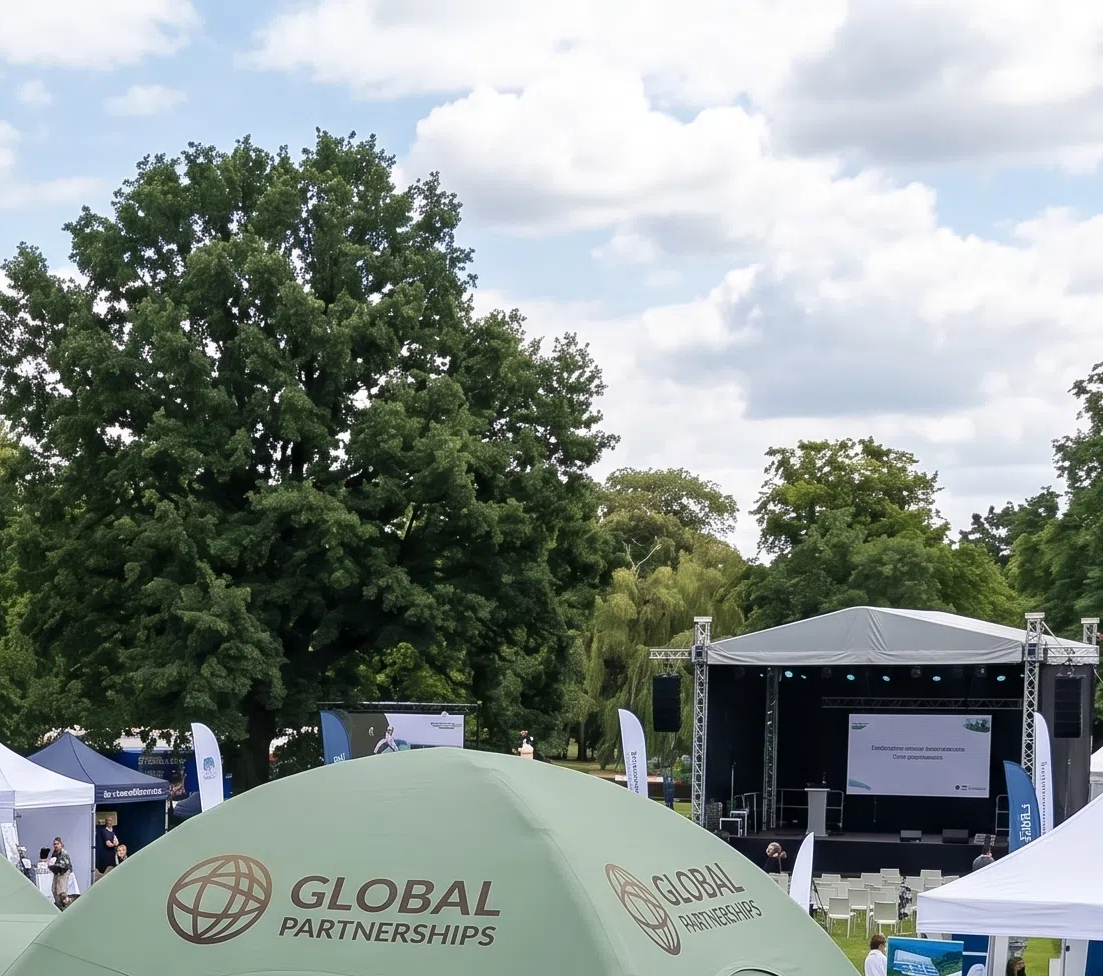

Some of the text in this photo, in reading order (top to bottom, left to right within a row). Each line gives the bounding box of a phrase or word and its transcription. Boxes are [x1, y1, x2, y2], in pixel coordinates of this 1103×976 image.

[290, 875, 501, 917] GLOBAL
[652, 862, 746, 906] GLOBAL
[278, 916, 497, 947] PARTNERSHIPS
[678, 899, 763, 934] PARTNERSHIPS
